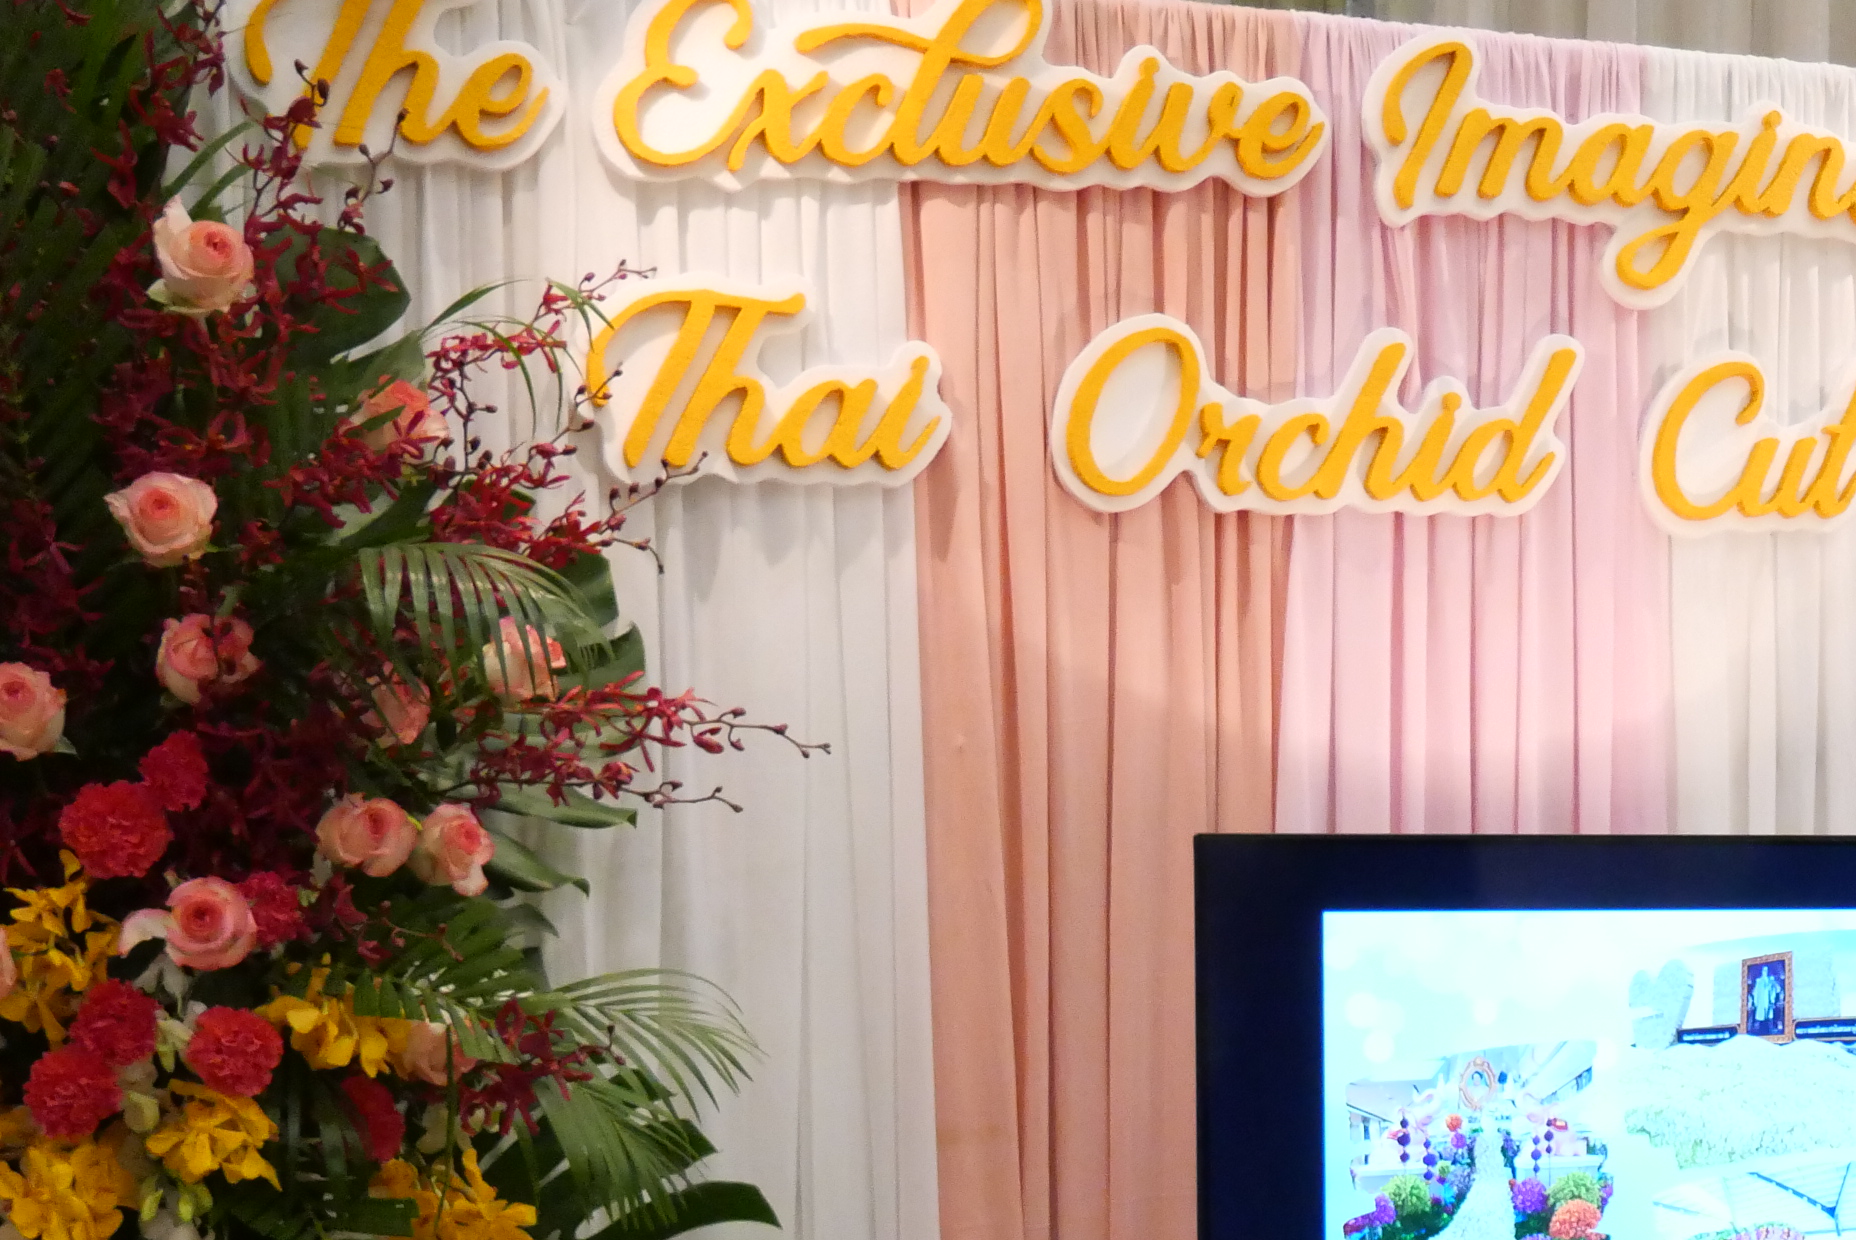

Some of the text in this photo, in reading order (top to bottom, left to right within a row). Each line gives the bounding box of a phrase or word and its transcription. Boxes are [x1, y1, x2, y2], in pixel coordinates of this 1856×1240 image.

[243, 0, 549, 153] The
[612, 0, 1325, 180] Exclusive
[586, 289, 940, 471] Thai
[1064, 326, 1577, 503] Orchid
